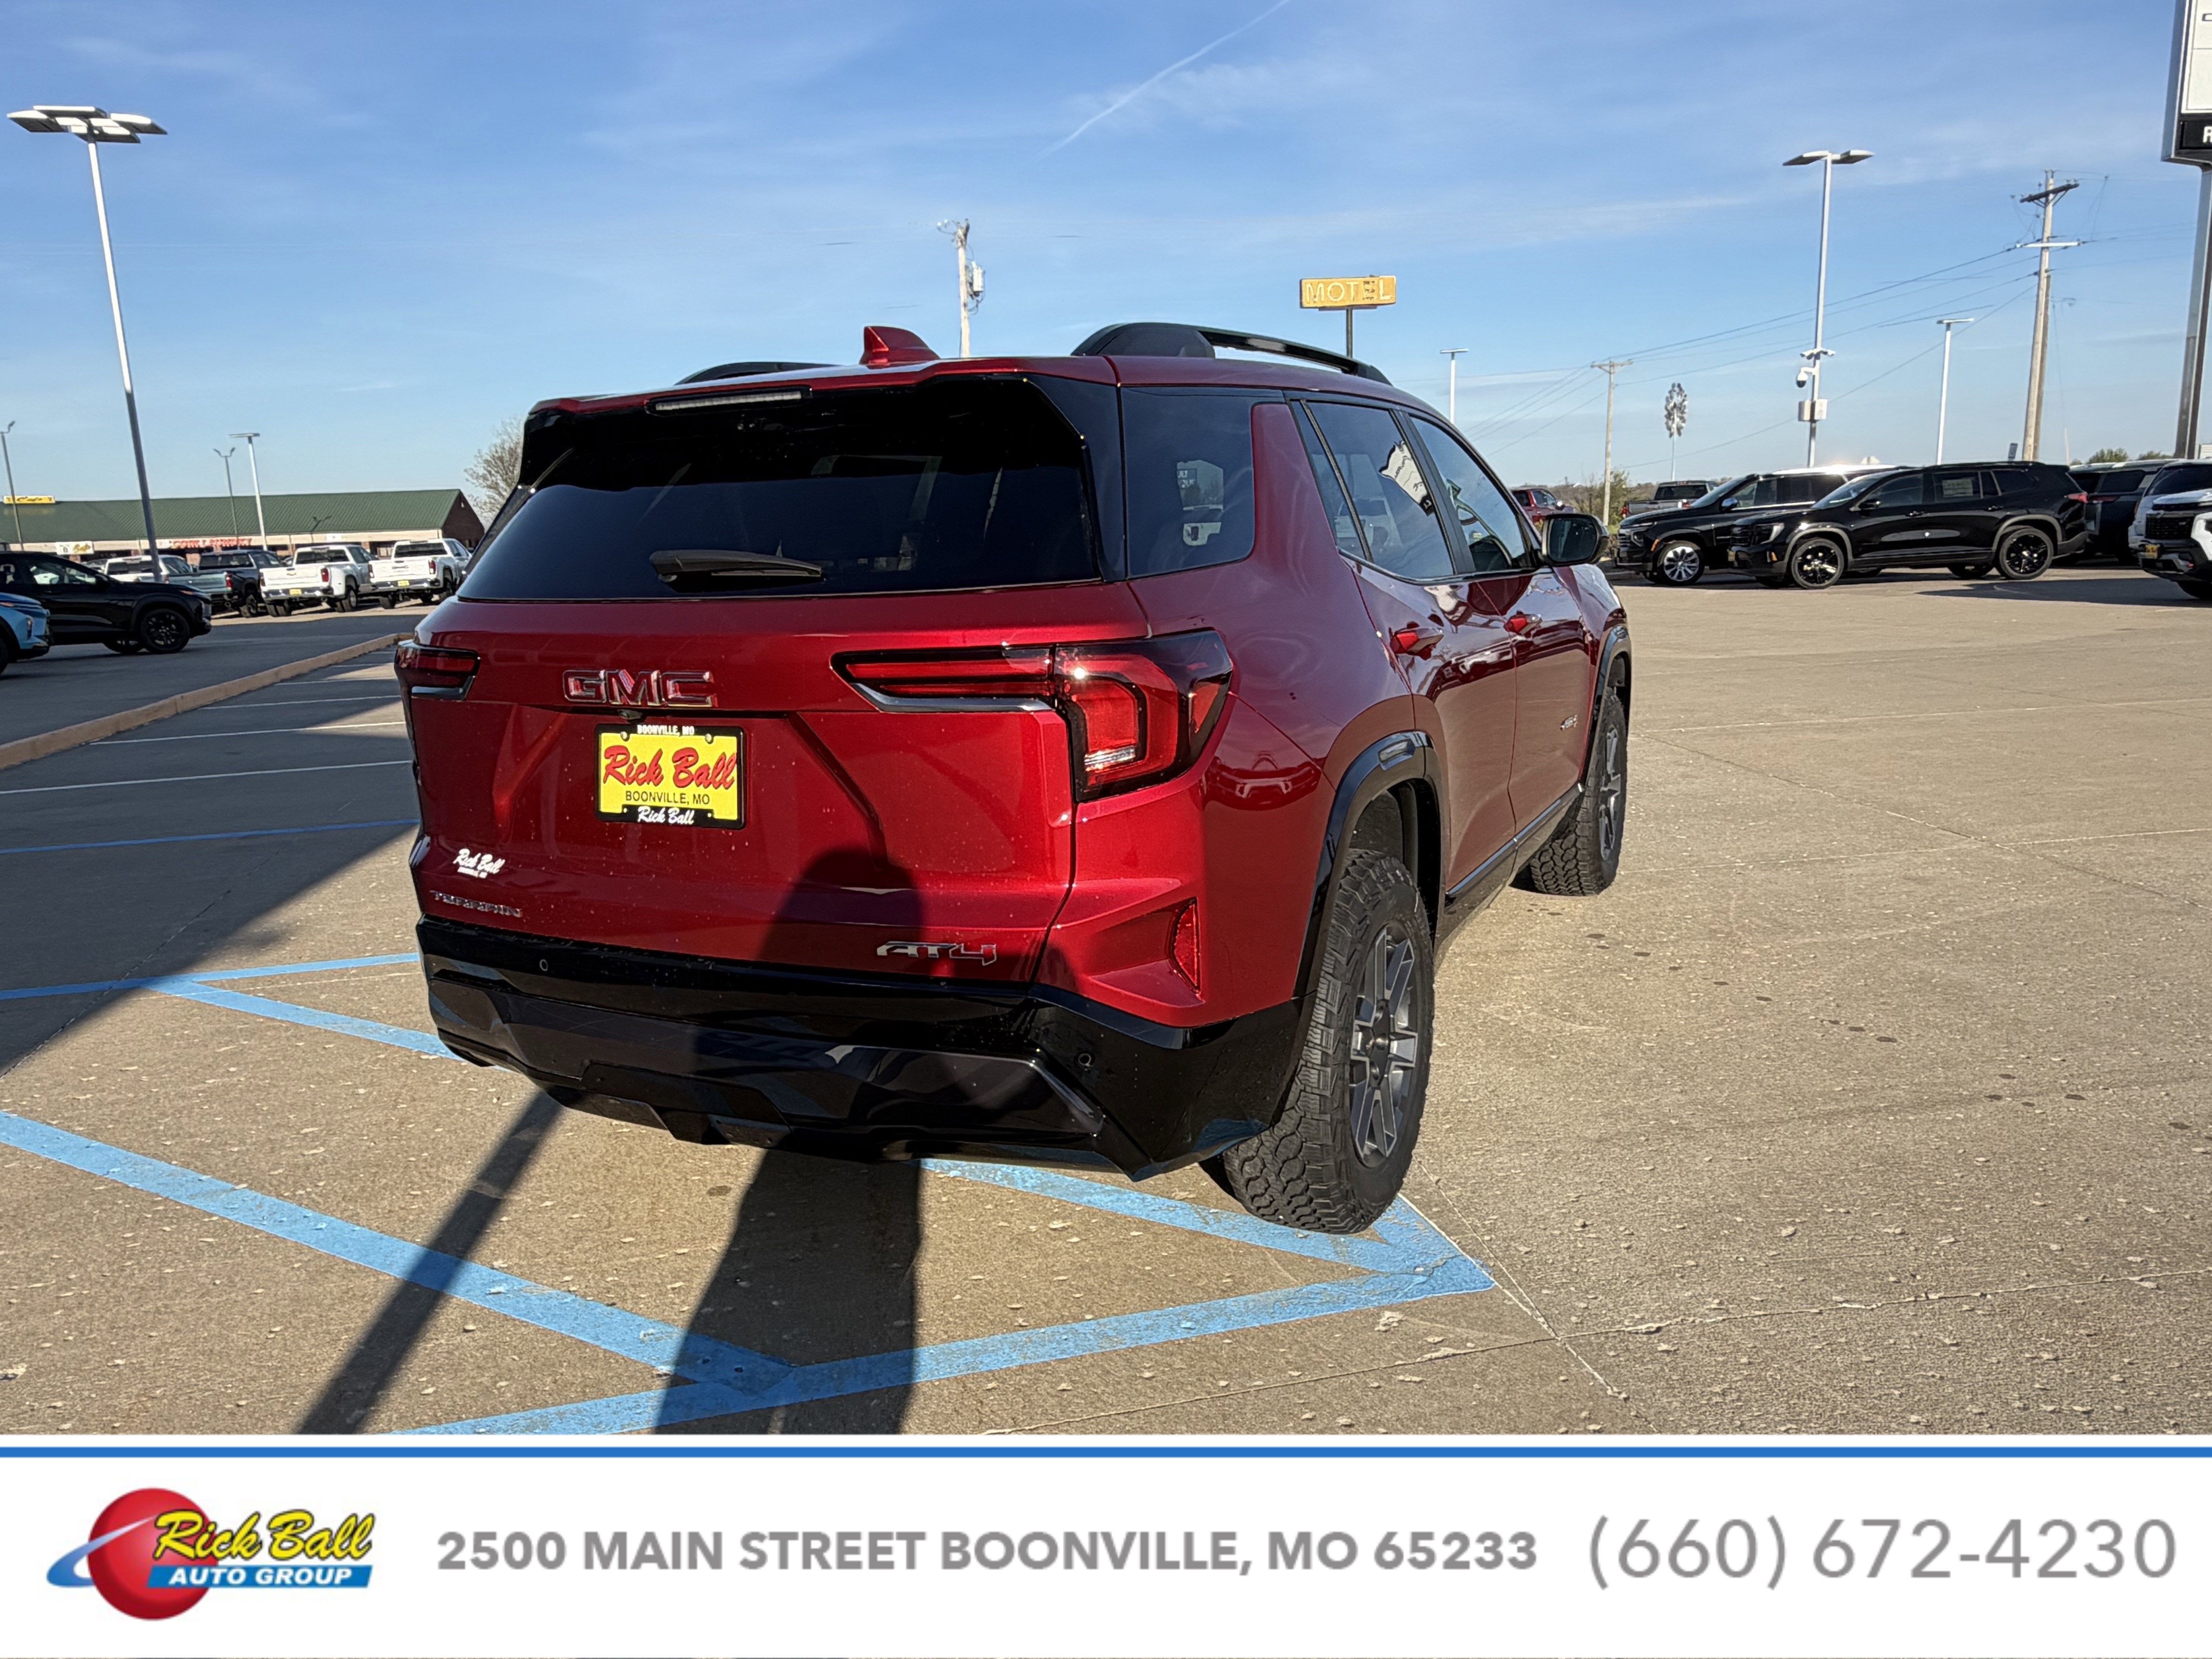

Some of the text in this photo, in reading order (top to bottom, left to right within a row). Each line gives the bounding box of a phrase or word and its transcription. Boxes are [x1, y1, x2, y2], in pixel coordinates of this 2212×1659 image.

[1306, 279, 1392, 304] MOTEL
[562, 669, 719, 708] GMC
[682, 726, 695, 735] MO
[603, 745, 737, 790] Rick Ball
[625, 790, 710, 805] BOONVILLE, MO
[637, 805, 695, 825] Rick Ball
[477, 854, 506, 874] Ball
[876, 941, 997, 966] AT4
